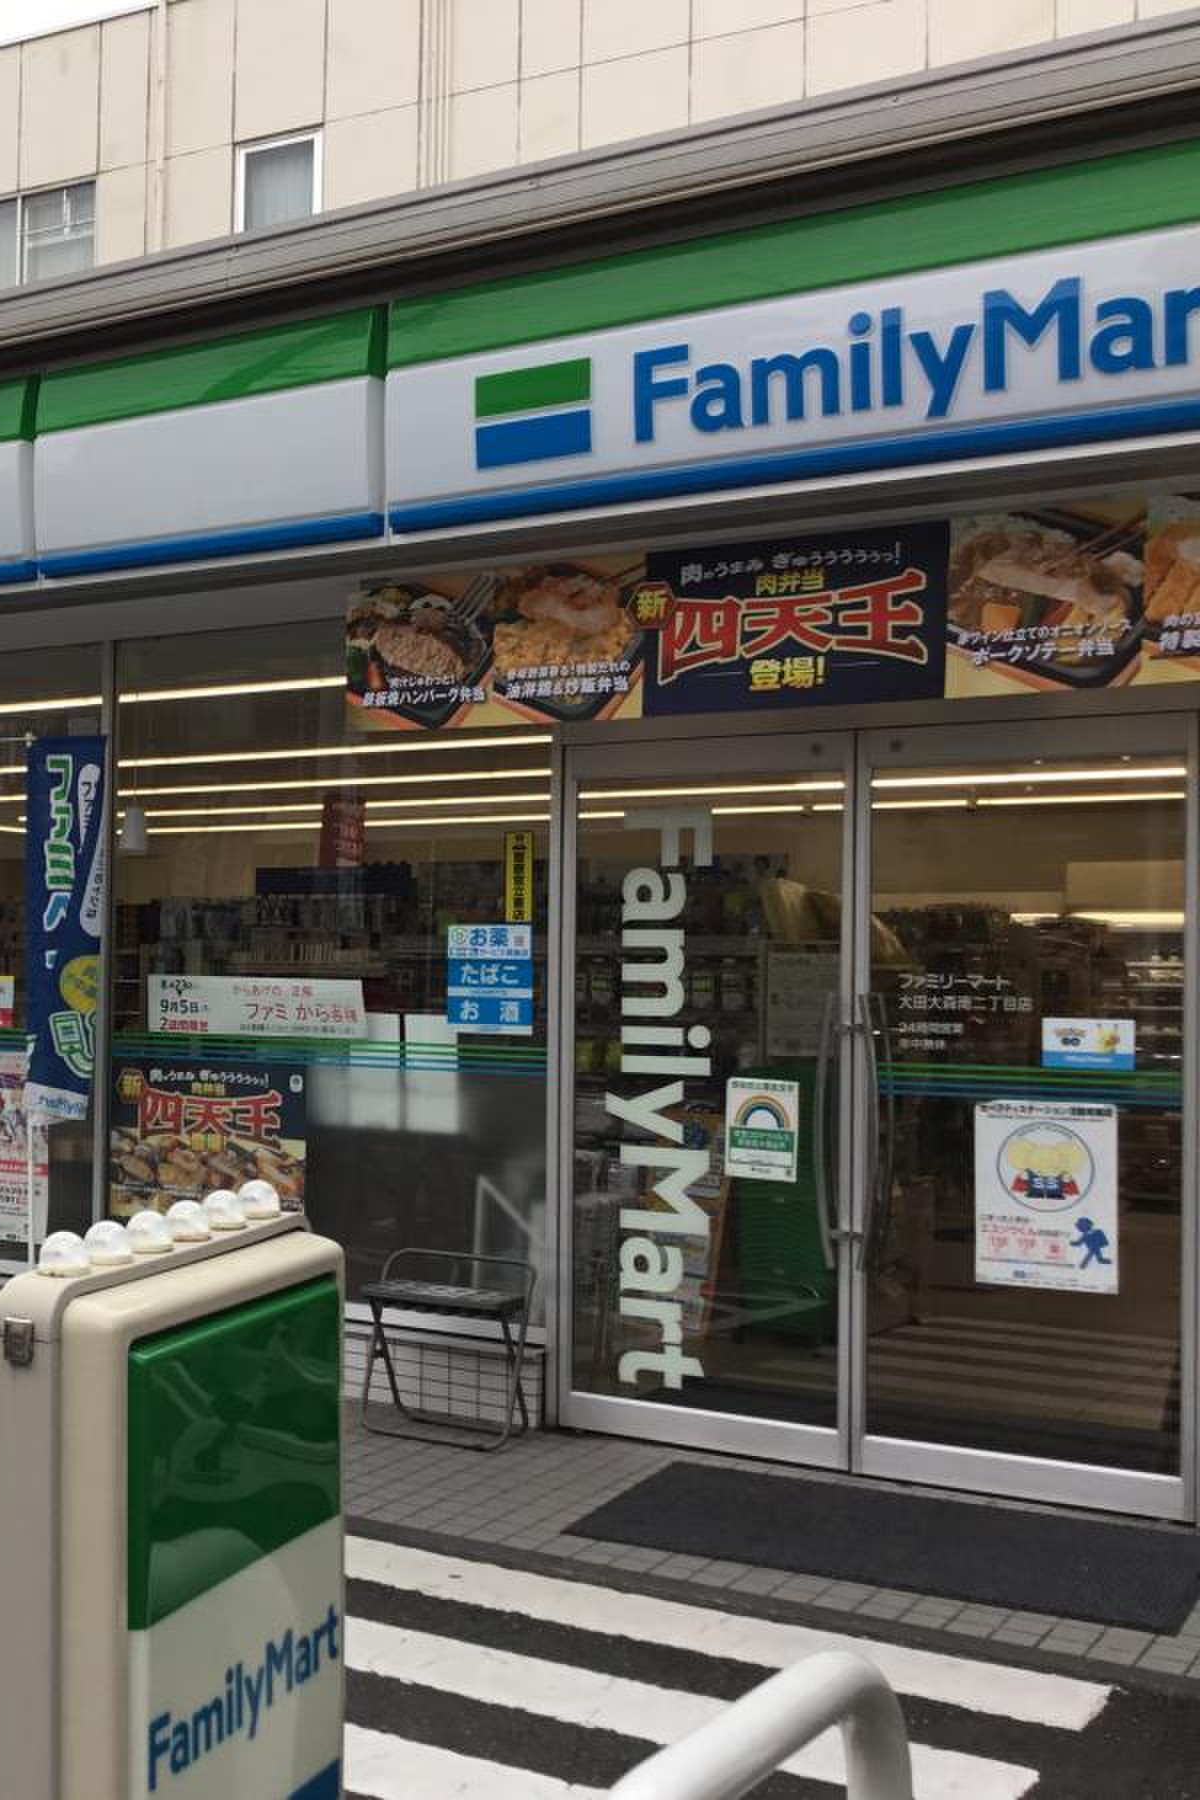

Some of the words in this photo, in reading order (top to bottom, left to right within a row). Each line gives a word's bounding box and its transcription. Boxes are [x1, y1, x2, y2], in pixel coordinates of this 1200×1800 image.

[755, 568, 825, 596] 肉弁当
[636, 588, 669, 621] 新
[657, 567, 929, 686] 四天王
[975, 639, 1116, 666] ポークソテー弁当
[749, 656, 825, 690] 登場!
[460, 962, 519, 985] たばこ
[898, 973, 1012, 991] ファミリーマート
[604, 808, 714, 1391] FamilyMart
[138, 1089, 283, 1150] 四天王
[147, 1604, 338, 1792] FamilyMart
